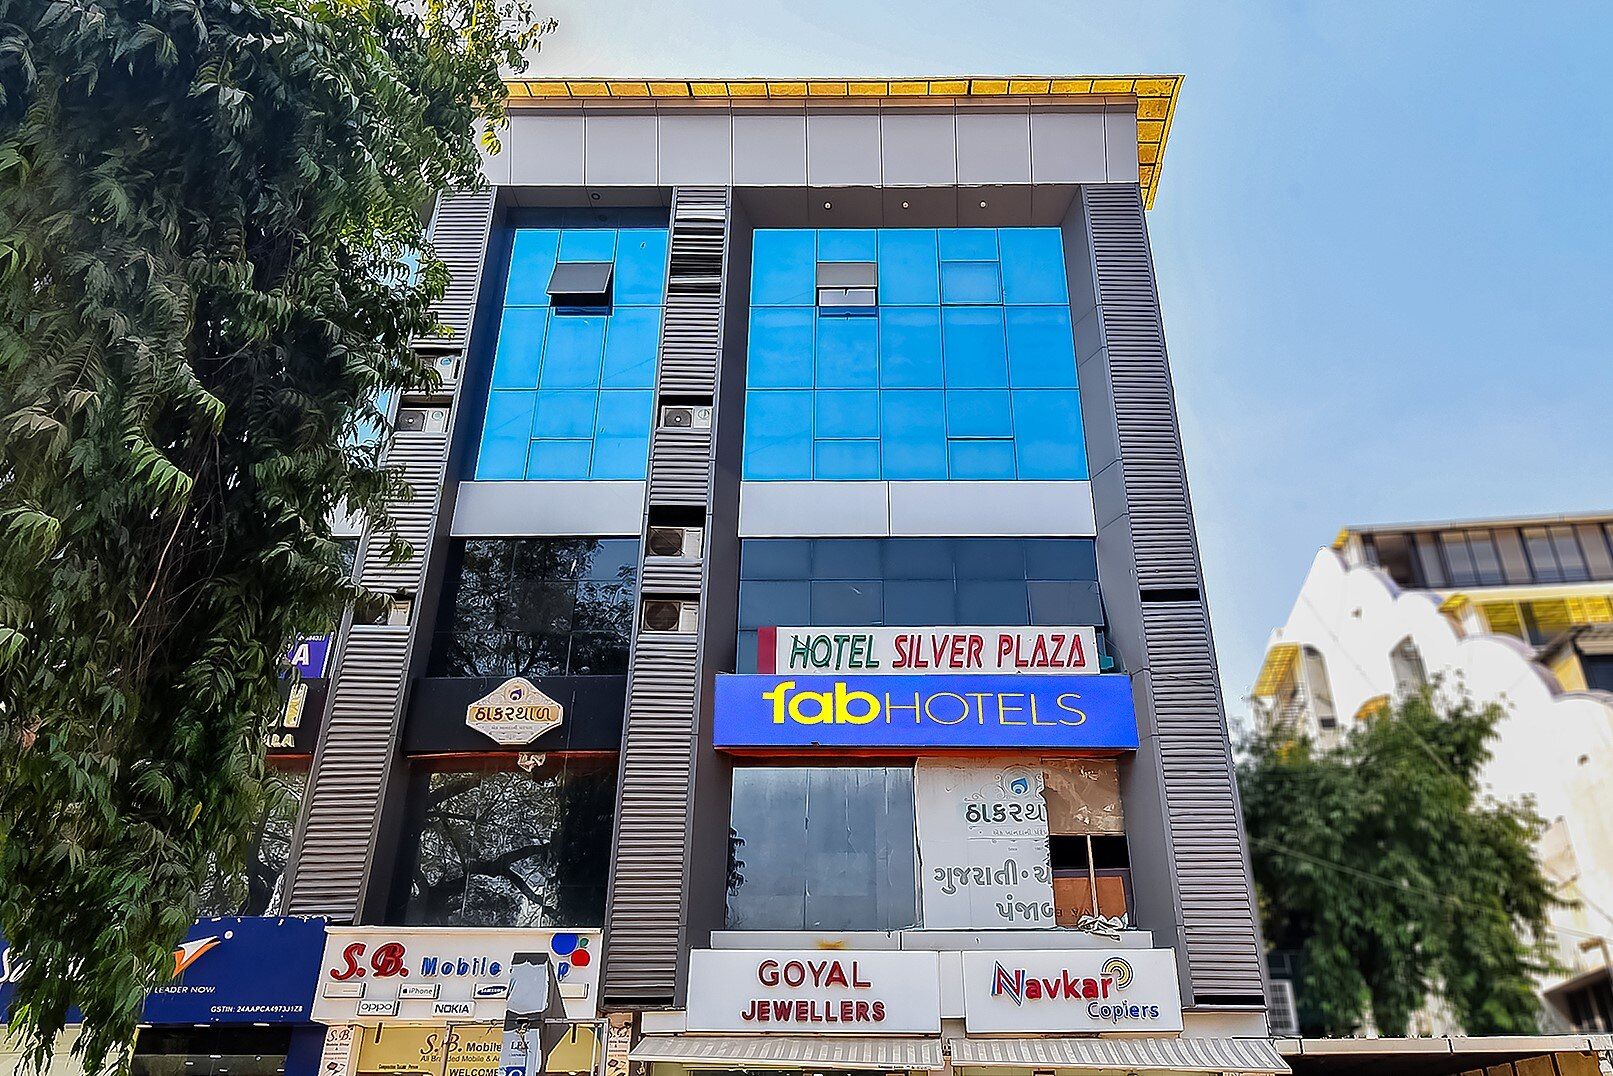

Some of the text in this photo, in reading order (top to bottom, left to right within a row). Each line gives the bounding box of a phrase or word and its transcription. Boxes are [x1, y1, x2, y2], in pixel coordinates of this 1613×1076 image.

[789, 633, 1086, 669] HOTEL SILVER PLAZA
[475, 706, 551, 721] ઠાકરથાળ
[965, 803, 1046, 823] ઠાકરથ
[933, 859, 1019, 895] ગુજરાતી
[329, 942, 410, 981] S.B.
[420, 956, 502, 977] Mobile
[757, 959, 872, 989] GOYAL
[991, 959, 1114, 1007] Navkar
[154, 986, 189, 994] LEADER
[210, 1005, 236, 1013] GSTIN:
[435, 1004, 470, 1014] NOKIA
[741, 999, 886, 1023] JEWELLERS
[1087, 1000, 1159, 1025] Copiers
[462, 1055, 484, 1063] Mobile
